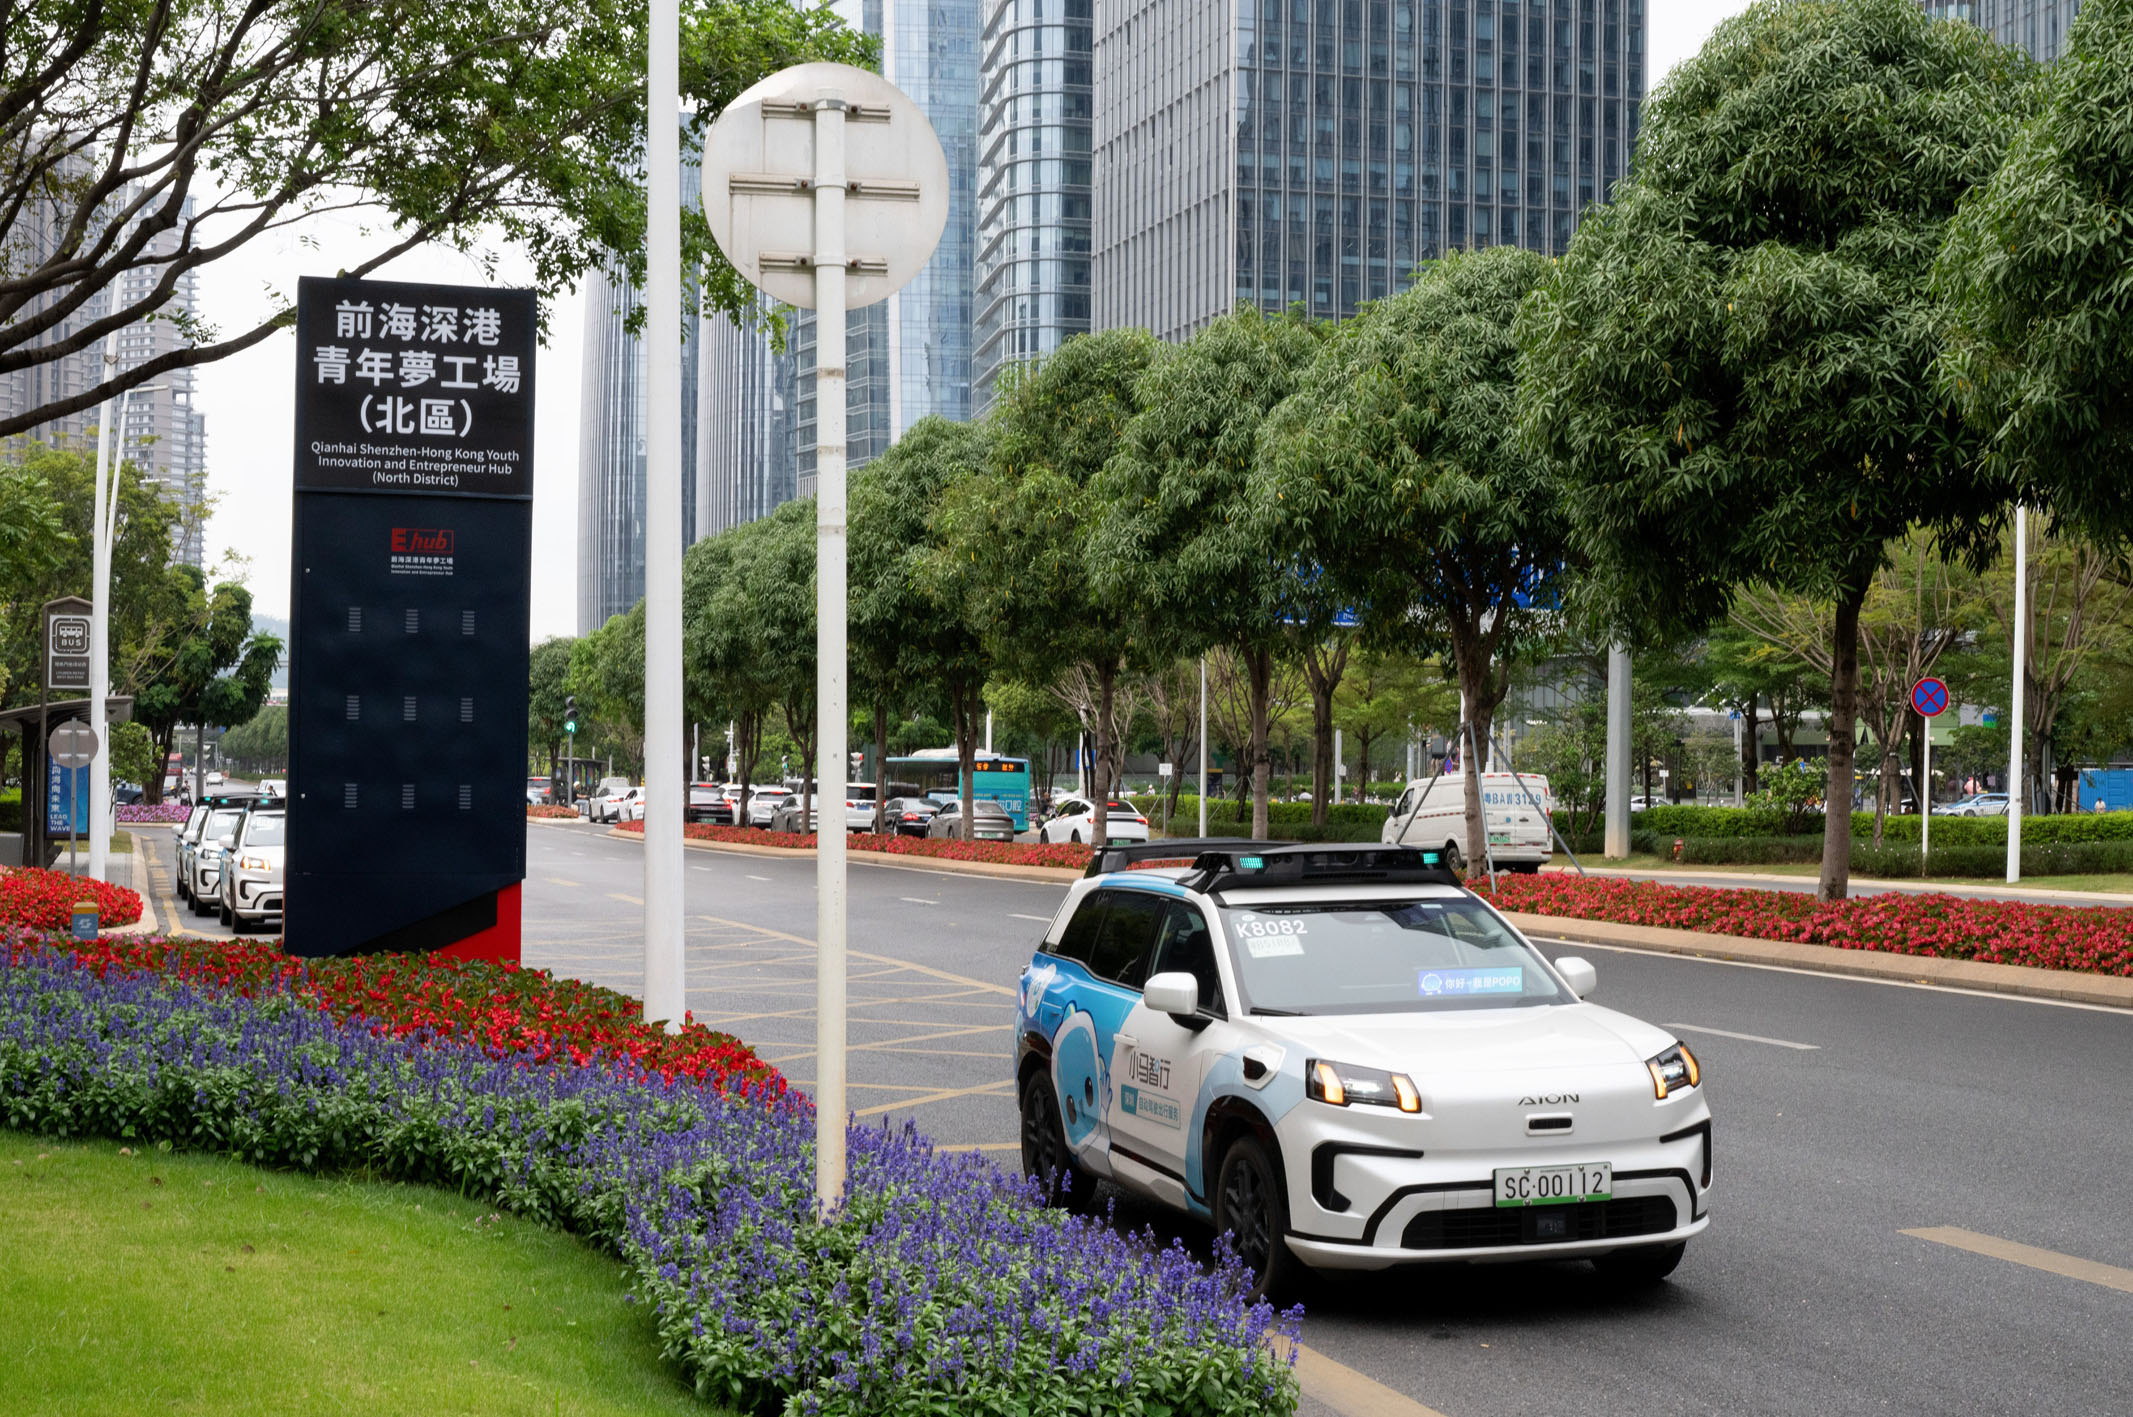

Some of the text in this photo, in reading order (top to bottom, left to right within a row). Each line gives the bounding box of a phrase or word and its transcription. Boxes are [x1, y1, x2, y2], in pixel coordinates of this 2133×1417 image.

[336, 299, 501, 346] 前海深港
[313, 345, 521, 394] 青年夢工場
[311, 441, 520, 461] Qianhai Shenzhen-Hong Kong Youth
[318, 456, 512, 475] Innovation and Entrepreneur Hub
[373, 471, 459, 488] (North District)
[61, 639, 81, 647] BUS
[1235, 919, 1308, 938] K8082
[1129, 1051, 1171, 1090] 小马智行
[1517, 1093, 1580, 1106] AION
